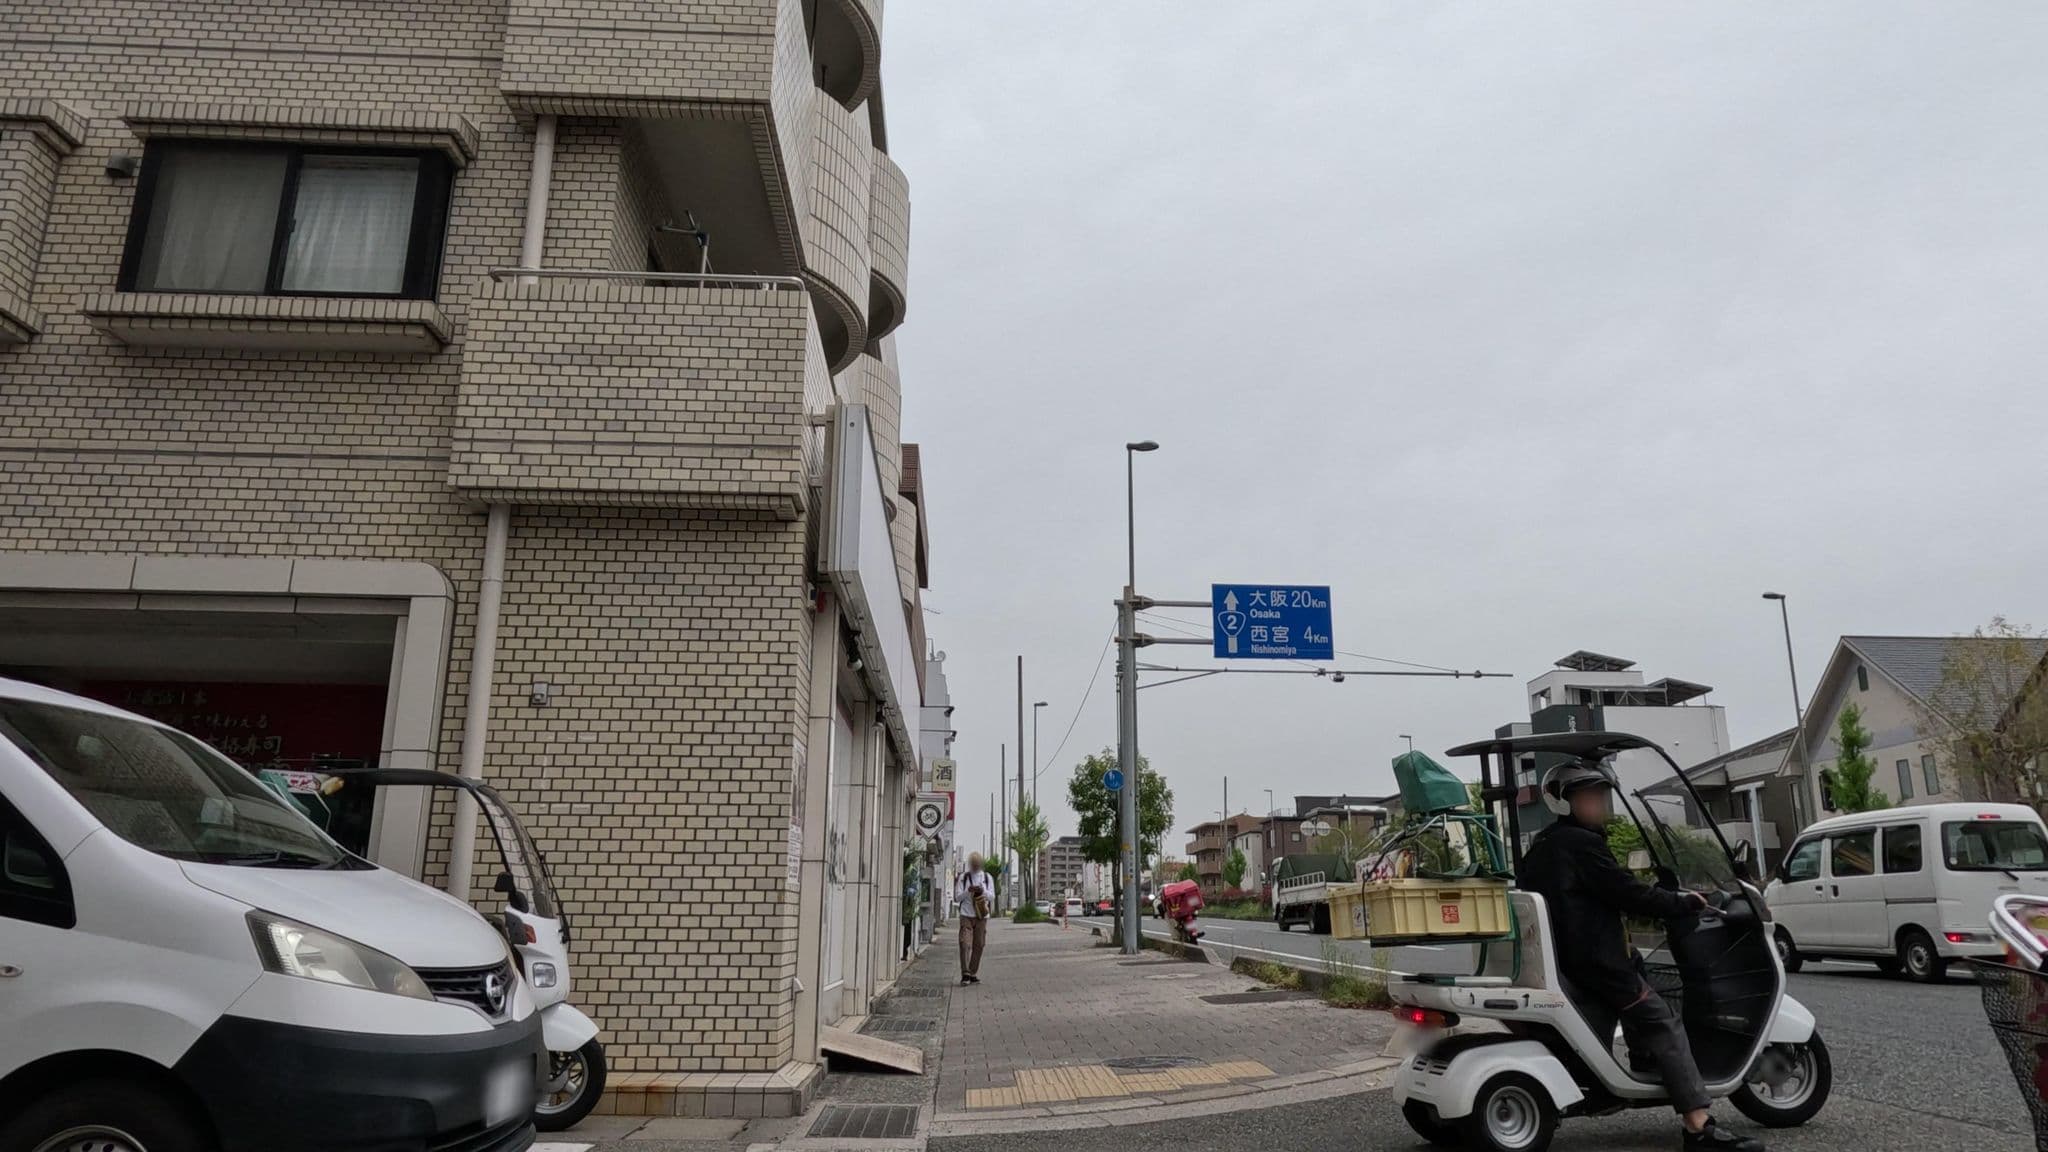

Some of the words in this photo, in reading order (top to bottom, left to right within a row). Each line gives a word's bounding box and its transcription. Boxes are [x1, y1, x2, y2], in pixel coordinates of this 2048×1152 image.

[1249, 590, 1288, 607] 大阪
[1250, 609, 1281, 619] Osaka
[1227, 615, 1237, 629] 2
[1250, 625, 1290, 642] 西宮
[1251, 644, 1297, 656] Nishinomiya
[936, 764, 952, 781] 酒
